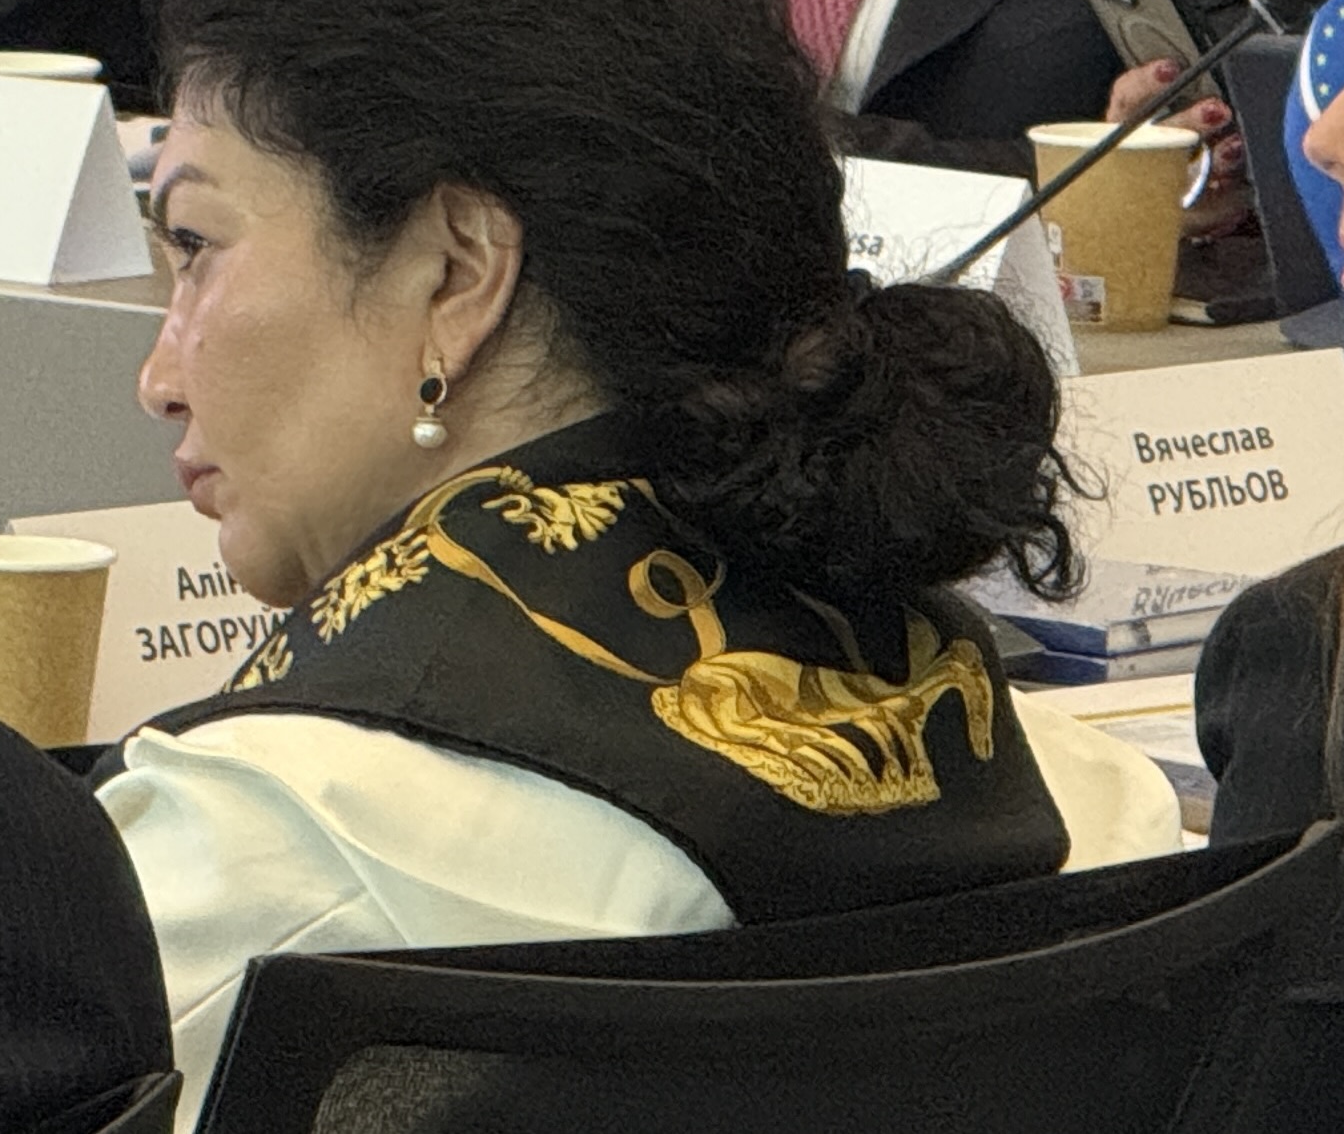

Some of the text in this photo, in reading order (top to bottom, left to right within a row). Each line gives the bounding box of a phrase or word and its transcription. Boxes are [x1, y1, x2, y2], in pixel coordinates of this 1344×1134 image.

[1133, 426, 1274, 464] Вячеслав
[1147, 469, 1289, 516] РУБЛЬОВ
[135, 605, 288, 661] ЗАГОРУЙ
